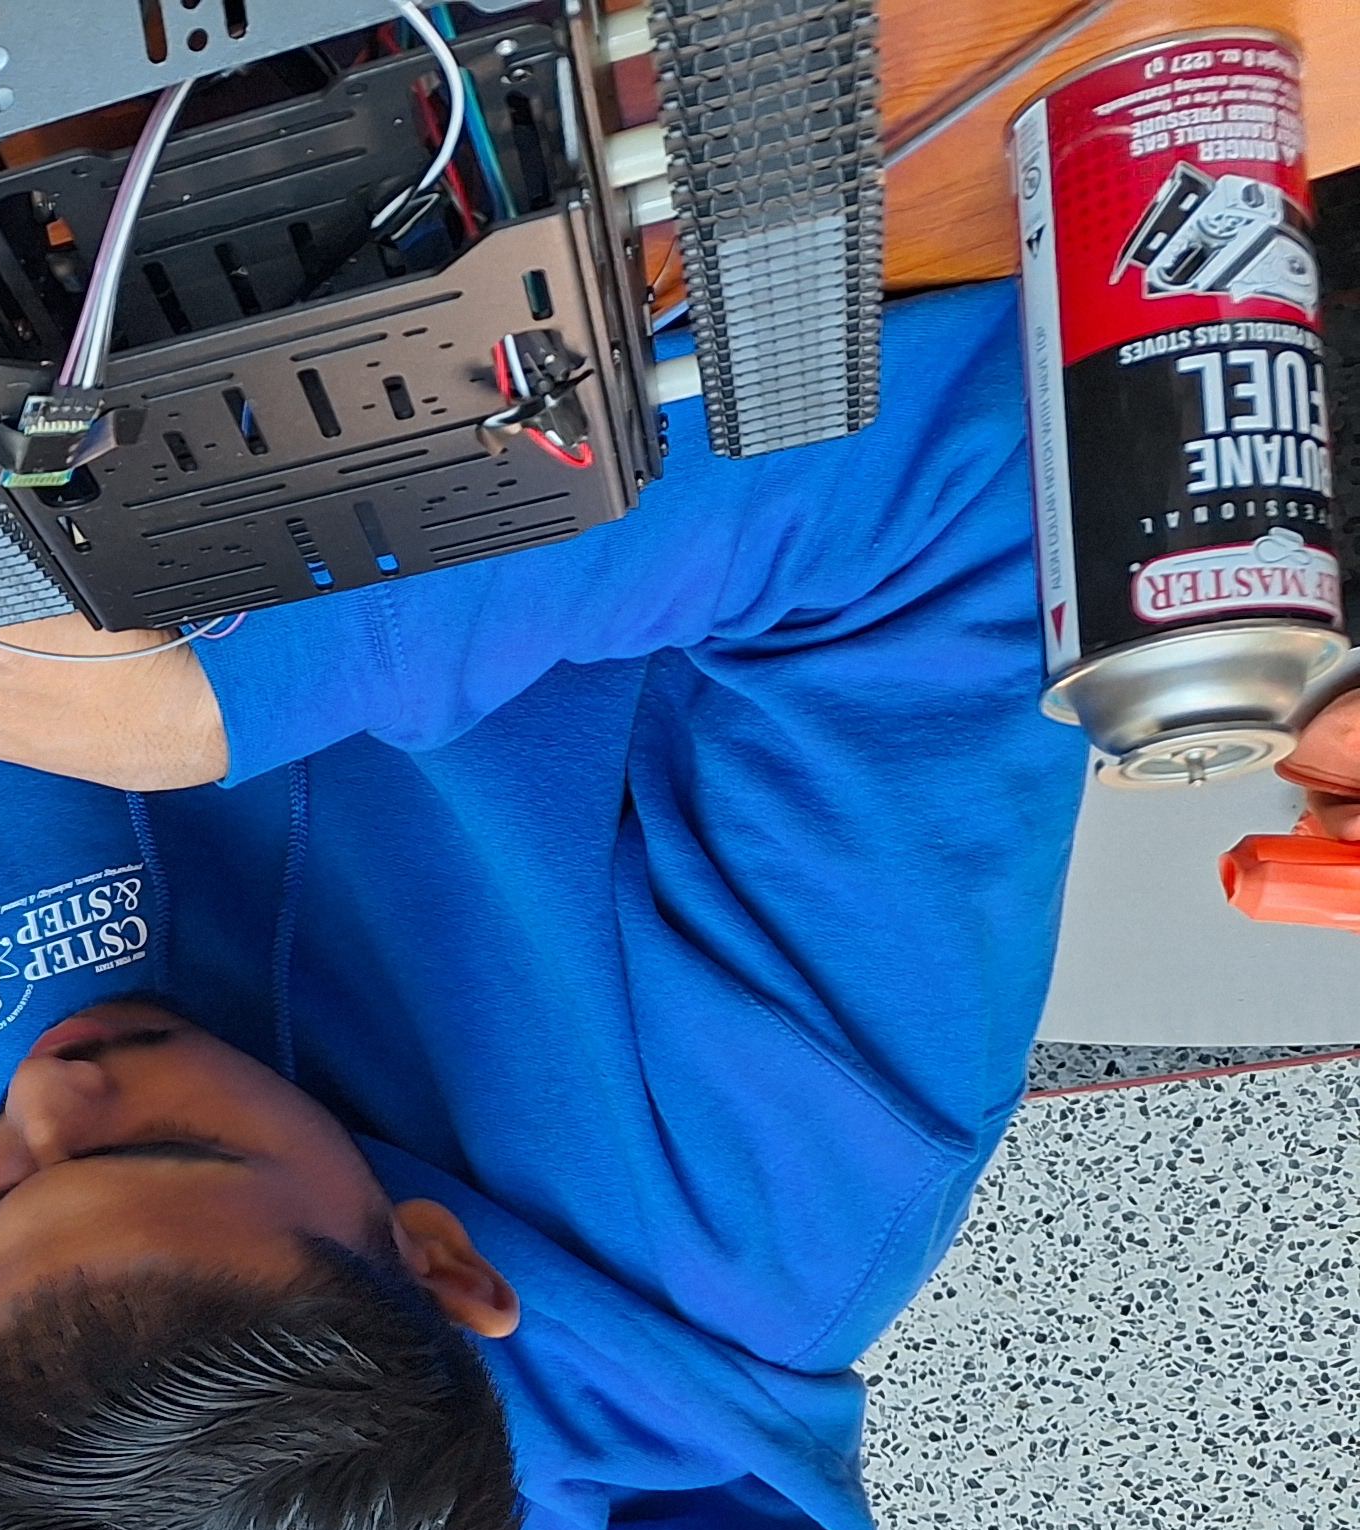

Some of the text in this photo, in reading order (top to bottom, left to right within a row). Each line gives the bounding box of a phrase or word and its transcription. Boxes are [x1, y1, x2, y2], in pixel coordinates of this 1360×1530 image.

[1170, 50, 1214, 74] (227
[1131, 104, 1224, 139] PRESSURE
[1174, 122, 1275, 146] FLAMMABLE
[1129, 131, 1169, 158] GAS
[1198, 139, 1277, 162] DANGER
[1118, 329, 1192, 365] STOVES
[1195, 322, 1231, 348] GAS
[1175, 349, 1330, 443] FUEL
[1183, 434, 1333, 498] BUTANE
[1144, 568, 1307, 611] MASTER
[16, 877, 142, 945] &STEP
[23, 915, 148, 981] CSTEP
